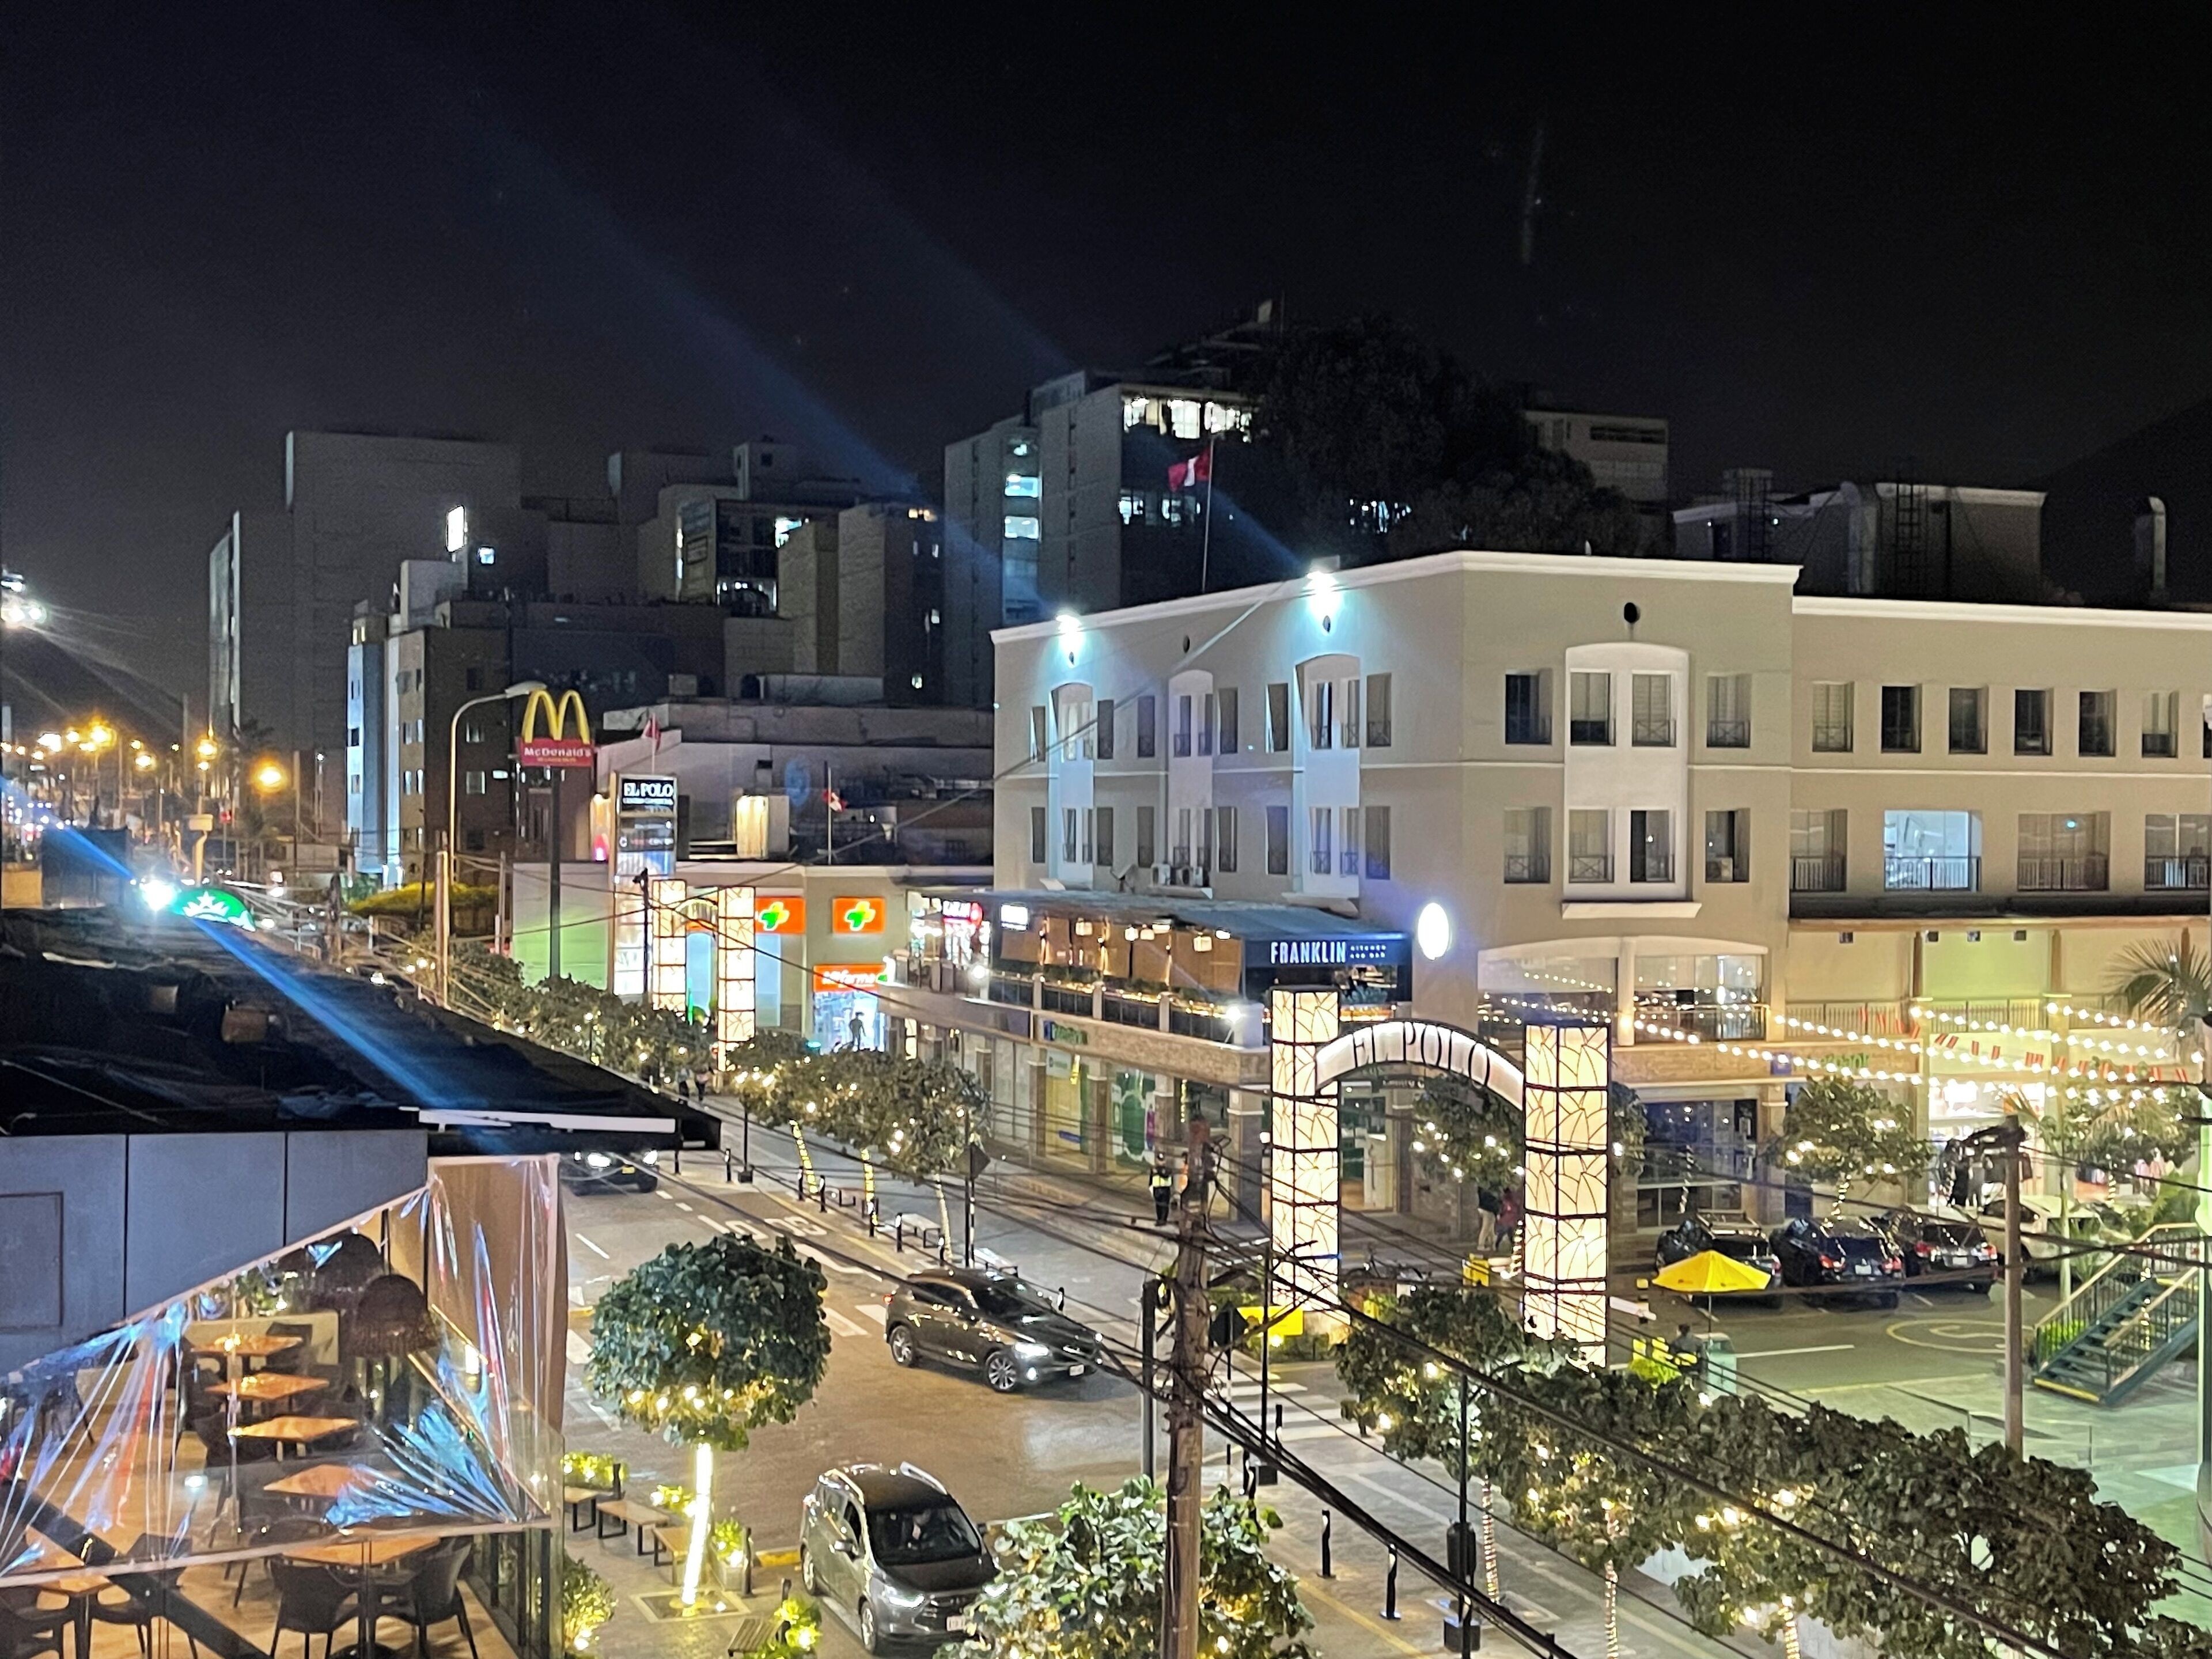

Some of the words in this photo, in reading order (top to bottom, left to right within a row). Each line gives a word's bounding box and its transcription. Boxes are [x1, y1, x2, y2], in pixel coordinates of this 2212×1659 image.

[524, 747, 592, 757] McDonald's
[624, 782, 639, 797] EL
[640, 783, 673, 797] POLO
[1271, 941, 1346, 964] FRANKLIN
[1352, 1025, 1389, 1068] EL
[1403, 1021, 1491, 1088] POLO
